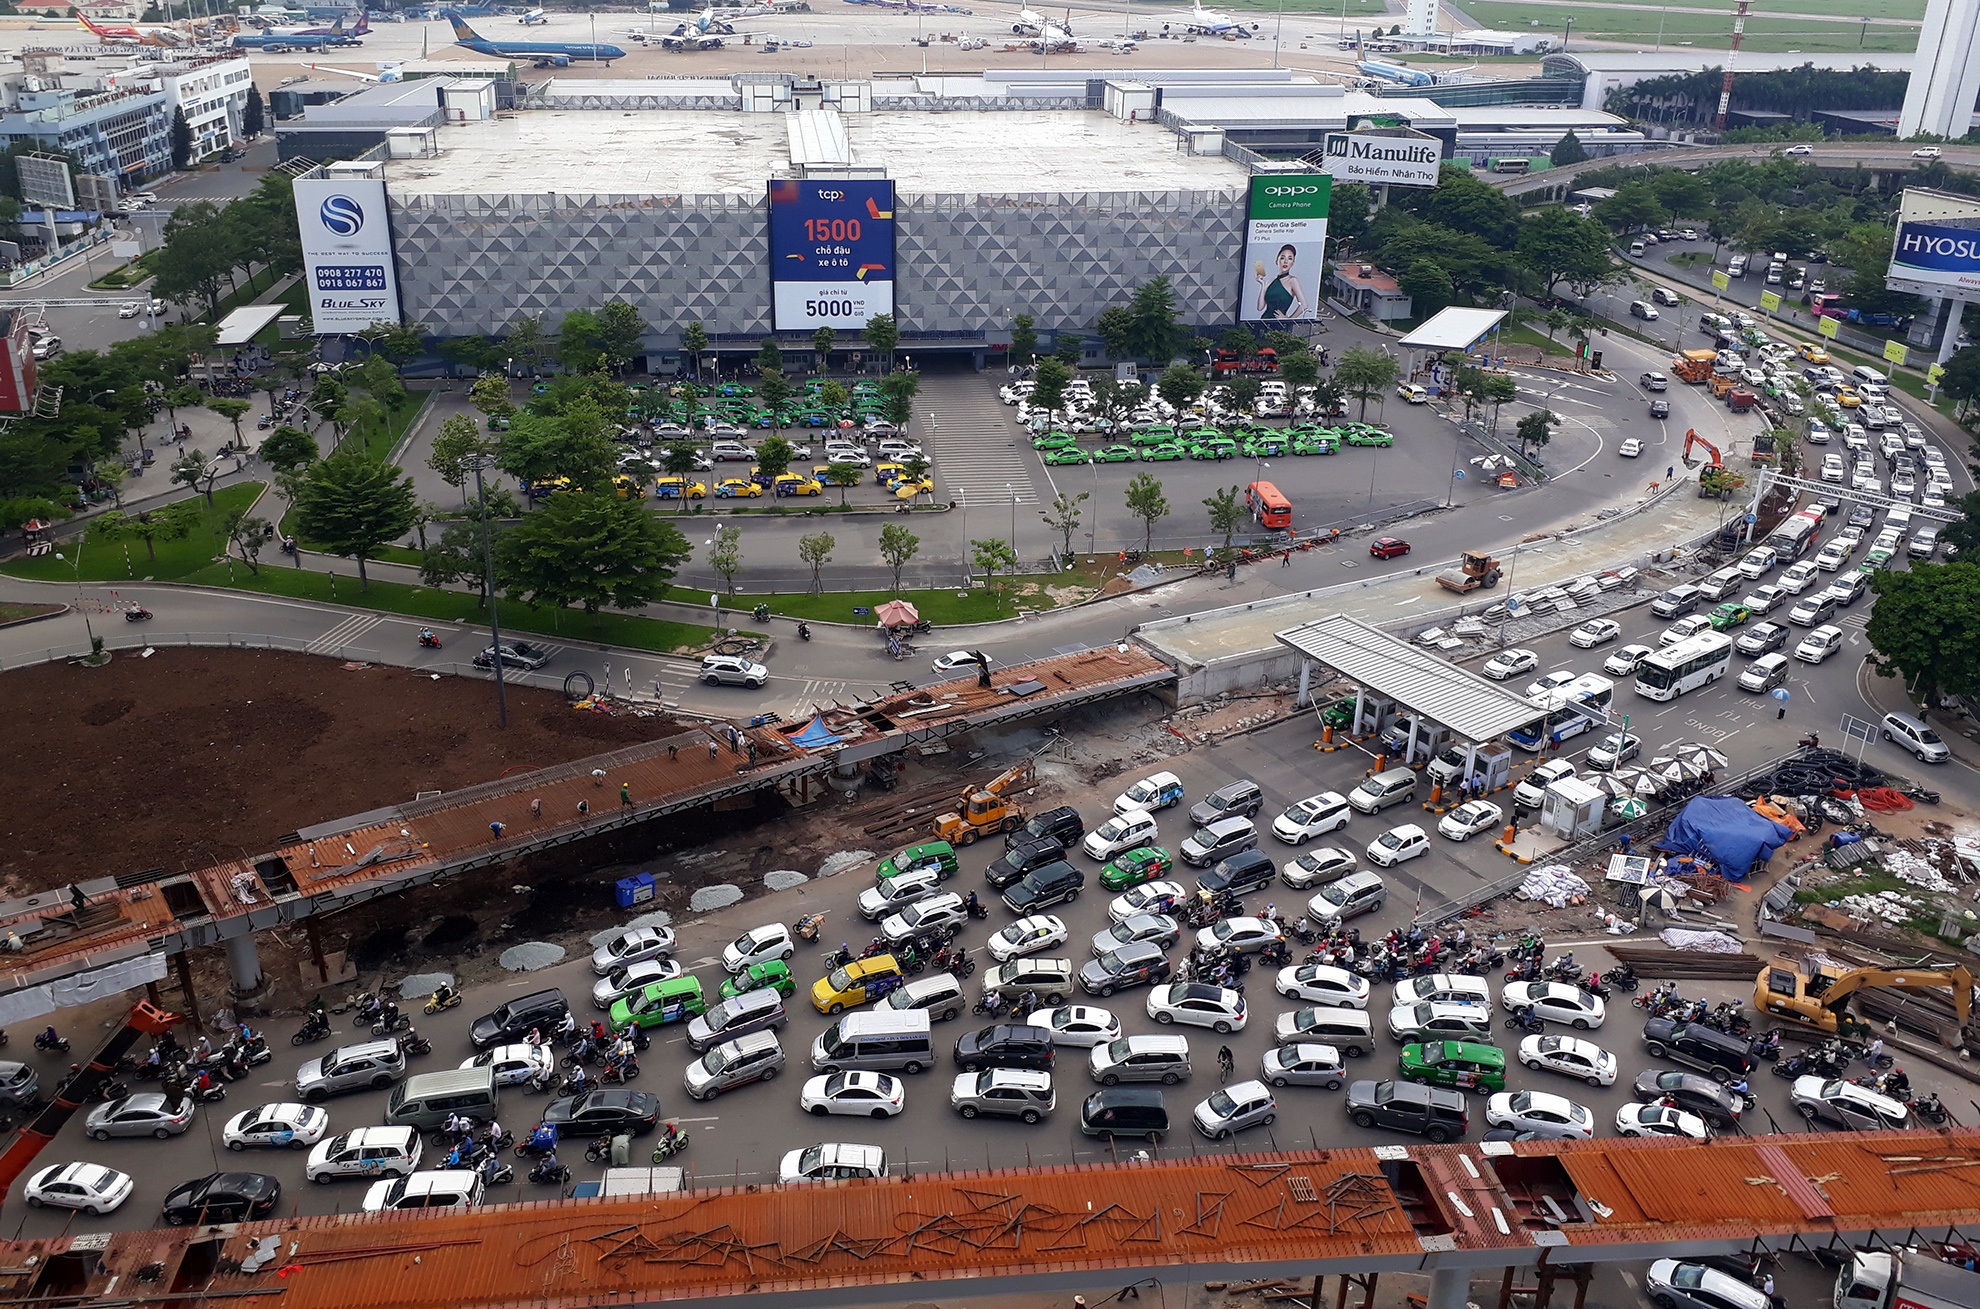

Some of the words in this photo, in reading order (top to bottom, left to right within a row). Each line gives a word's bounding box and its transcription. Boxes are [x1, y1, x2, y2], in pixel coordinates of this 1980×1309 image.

[1350, 141, 1437, 164] Manulife
[1348, 165, 1364, 175] Bảo
[1365, 166, 1389, 176] Hiểm
[1391, 167, 1415, 179] Nhân
[1417, 170, 1434, 181] Thọ
[1292, 200, 1312, 208] Phone
[804, 219, 861, 241] 1500
[831, 258, 837, 267] ô
[839, 258, 849, 267] tô
[318, 268, 342, 278] 0908
[344, 268, 361, 278] 277
[364, 268, 383, 278] 470
[319, 279, 343, 288] 0918
[345, 279, 362, 288] 067
[366, 279, 383, 288] 867
[806, 300, 852, 317] 5000
